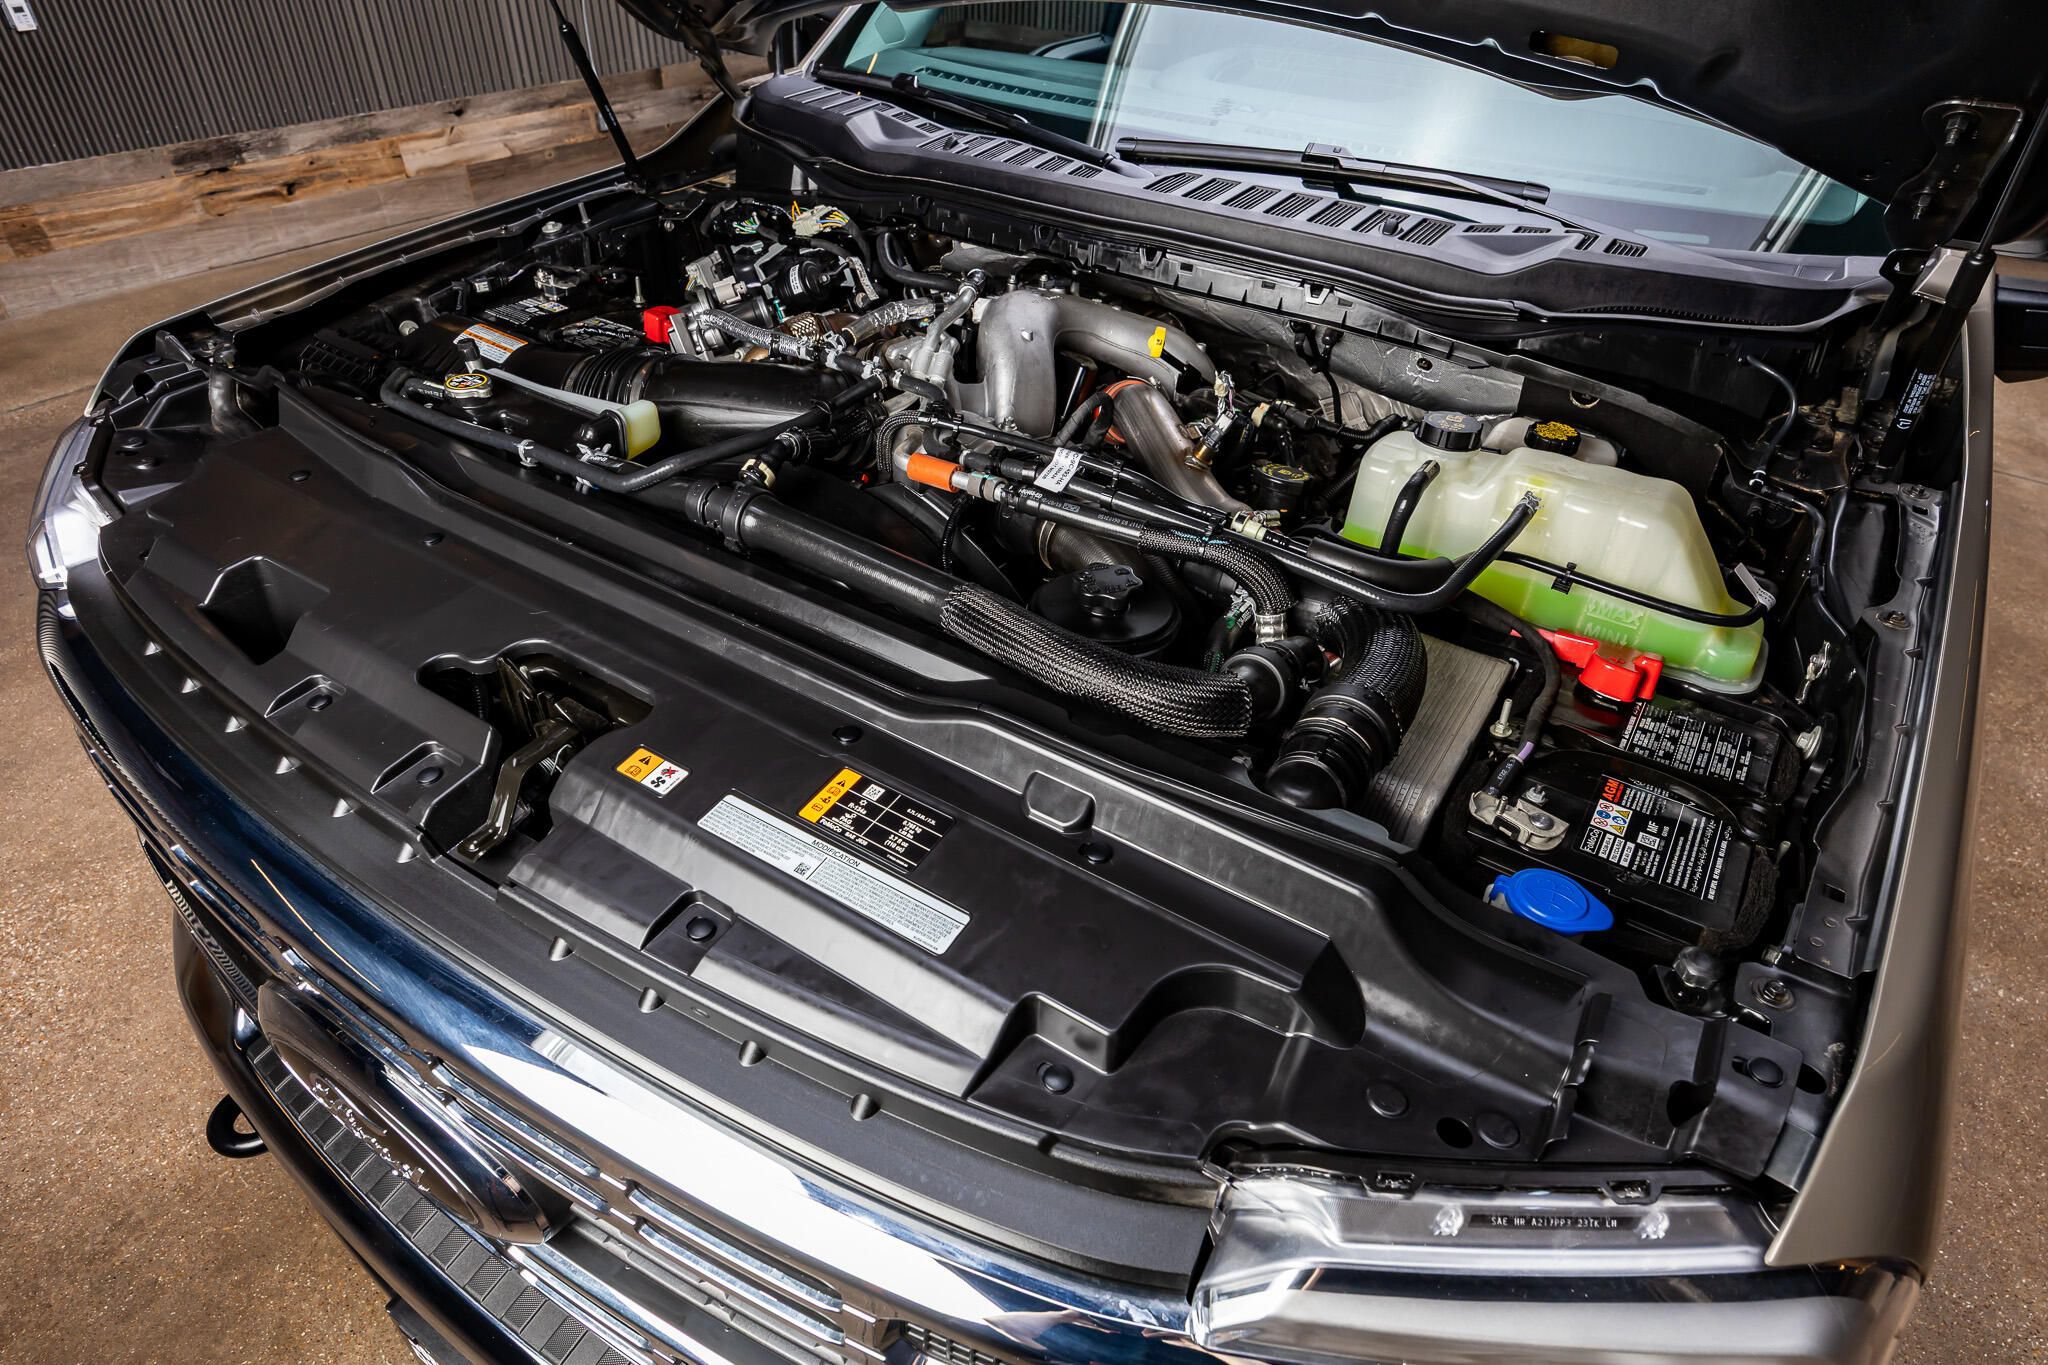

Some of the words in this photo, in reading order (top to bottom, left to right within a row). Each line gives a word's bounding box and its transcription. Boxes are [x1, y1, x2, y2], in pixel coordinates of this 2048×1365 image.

[1602, 779, 1620, 801] AGM
[848, 803, 868, 815] R-134a
[819, 818, 842, 833] FoMoCo
[839, 816, 852, 825] PAG
[1646, 820, 1660, 834] MF
[1584, 828, 1600, 852] FoMoCo
[811, 839, 861, 867] MODIFICATION
[1491, 1217, 1508, 1226] SAE
[1514, 1217, 1525, 1226] HR
[1606, 1217, 1617, 1228] LH
